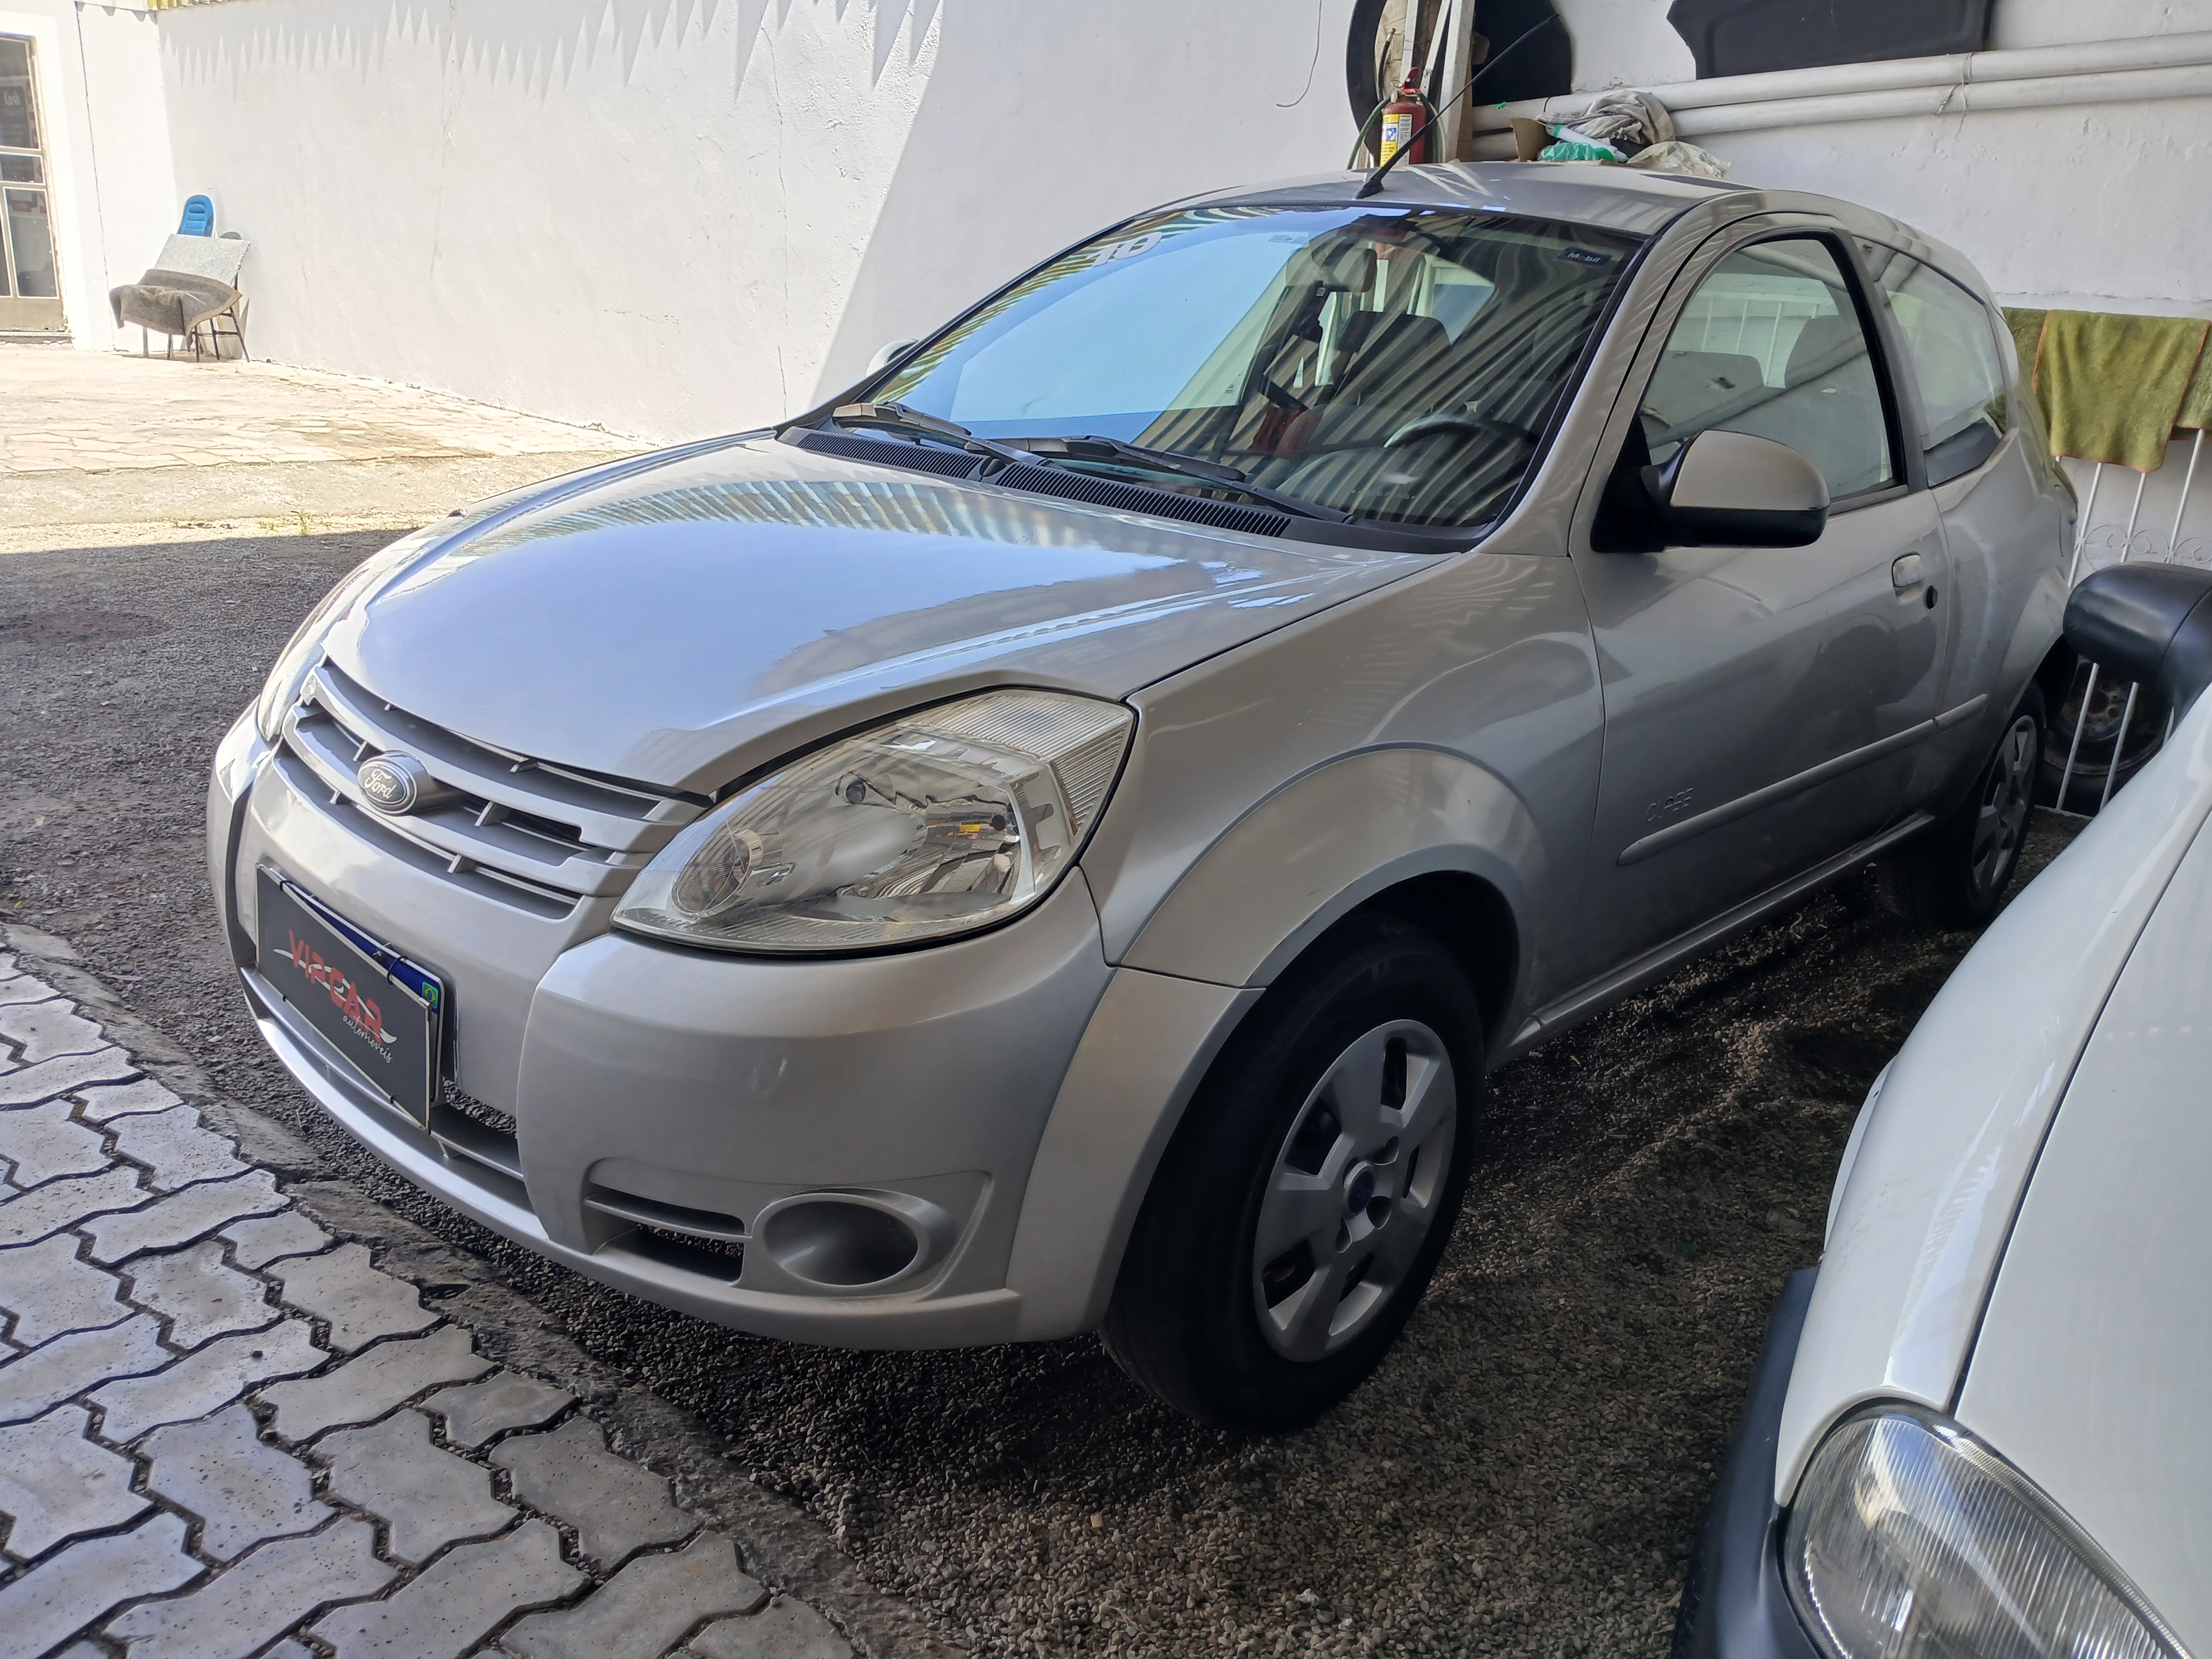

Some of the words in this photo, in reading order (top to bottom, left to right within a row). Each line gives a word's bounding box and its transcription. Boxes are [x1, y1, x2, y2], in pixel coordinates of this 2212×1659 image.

[1567, 252, 1601, 263] Mobil
[364, 768, 397, 799] Ford
[289, 928, 382, 1044] VIPCAR
[343, 1015, 394, 1064] automoveis
